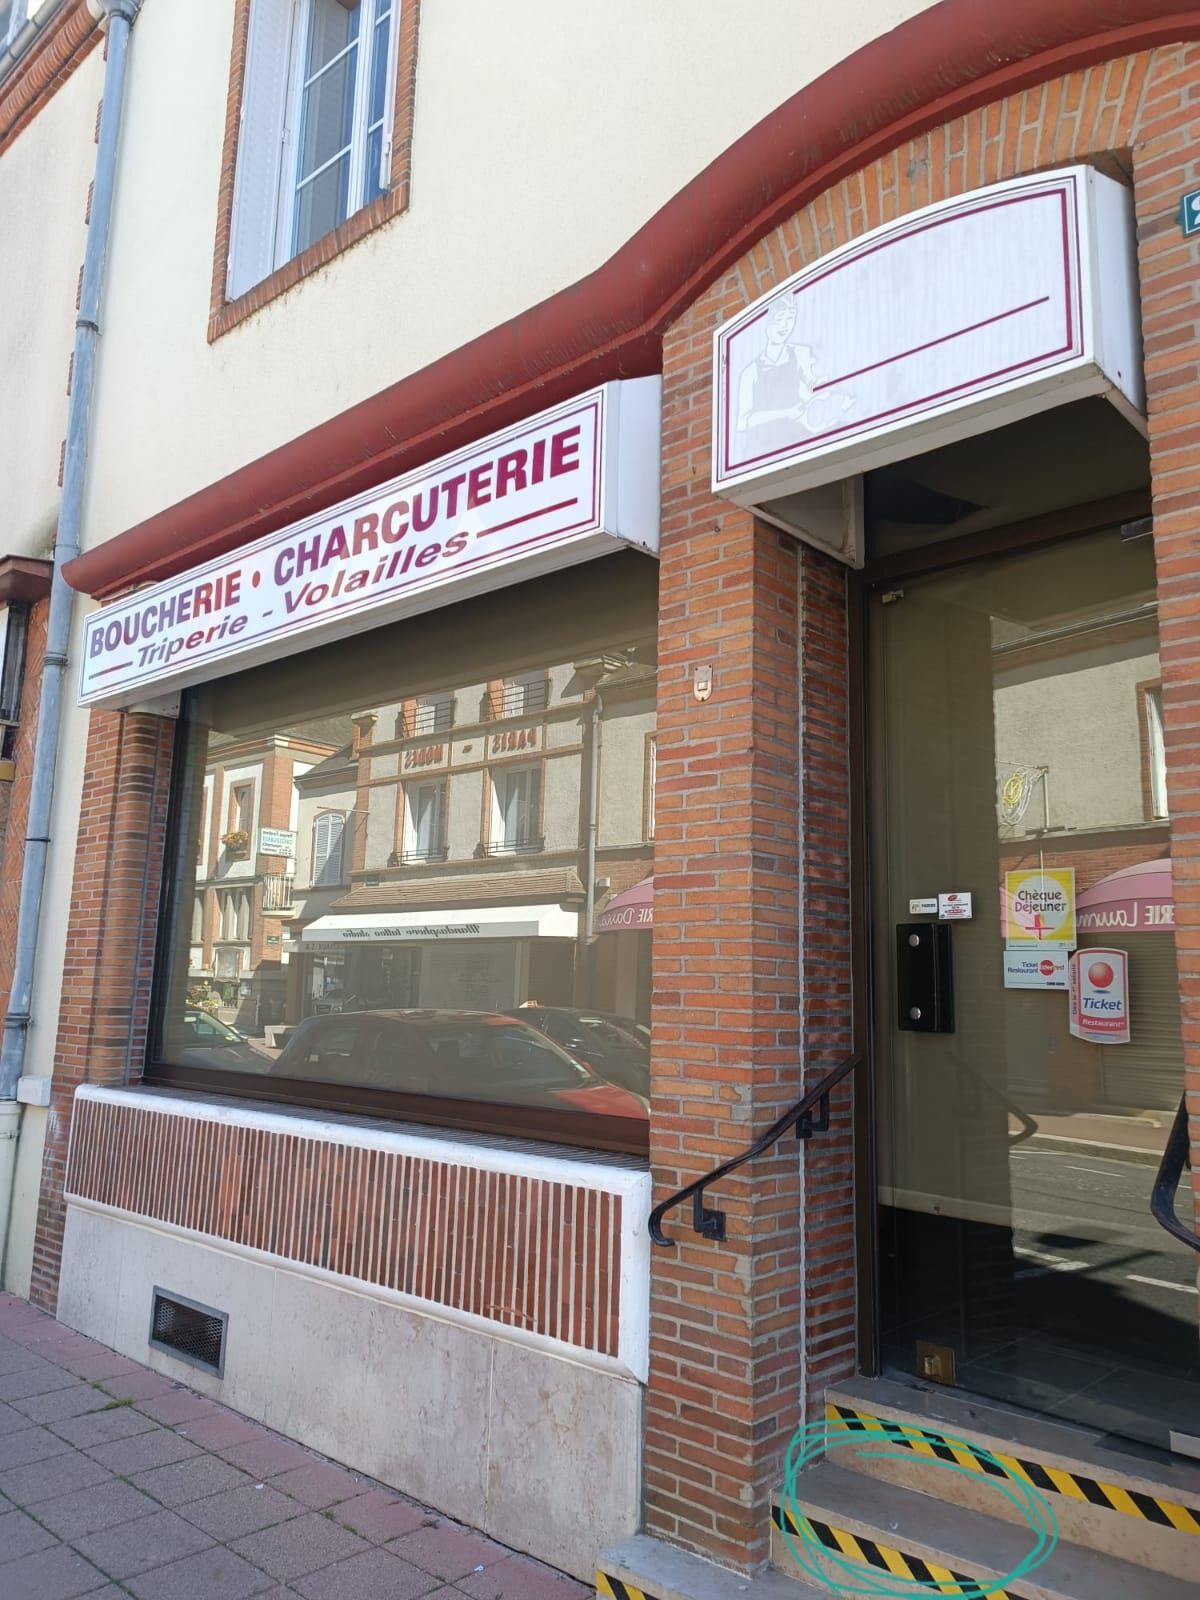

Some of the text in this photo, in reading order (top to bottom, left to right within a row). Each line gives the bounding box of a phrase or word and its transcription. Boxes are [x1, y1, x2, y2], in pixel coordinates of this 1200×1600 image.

[90, 425, 581, 658] BOUCHERIE CHARCUTERIE
[137, 613, 249, 668] Triperie
[283, 532, 469, 614] Volailles
[1018, 889, 1062, 902] Chèque
[1083, 997, 1122, 1011] Ticket
